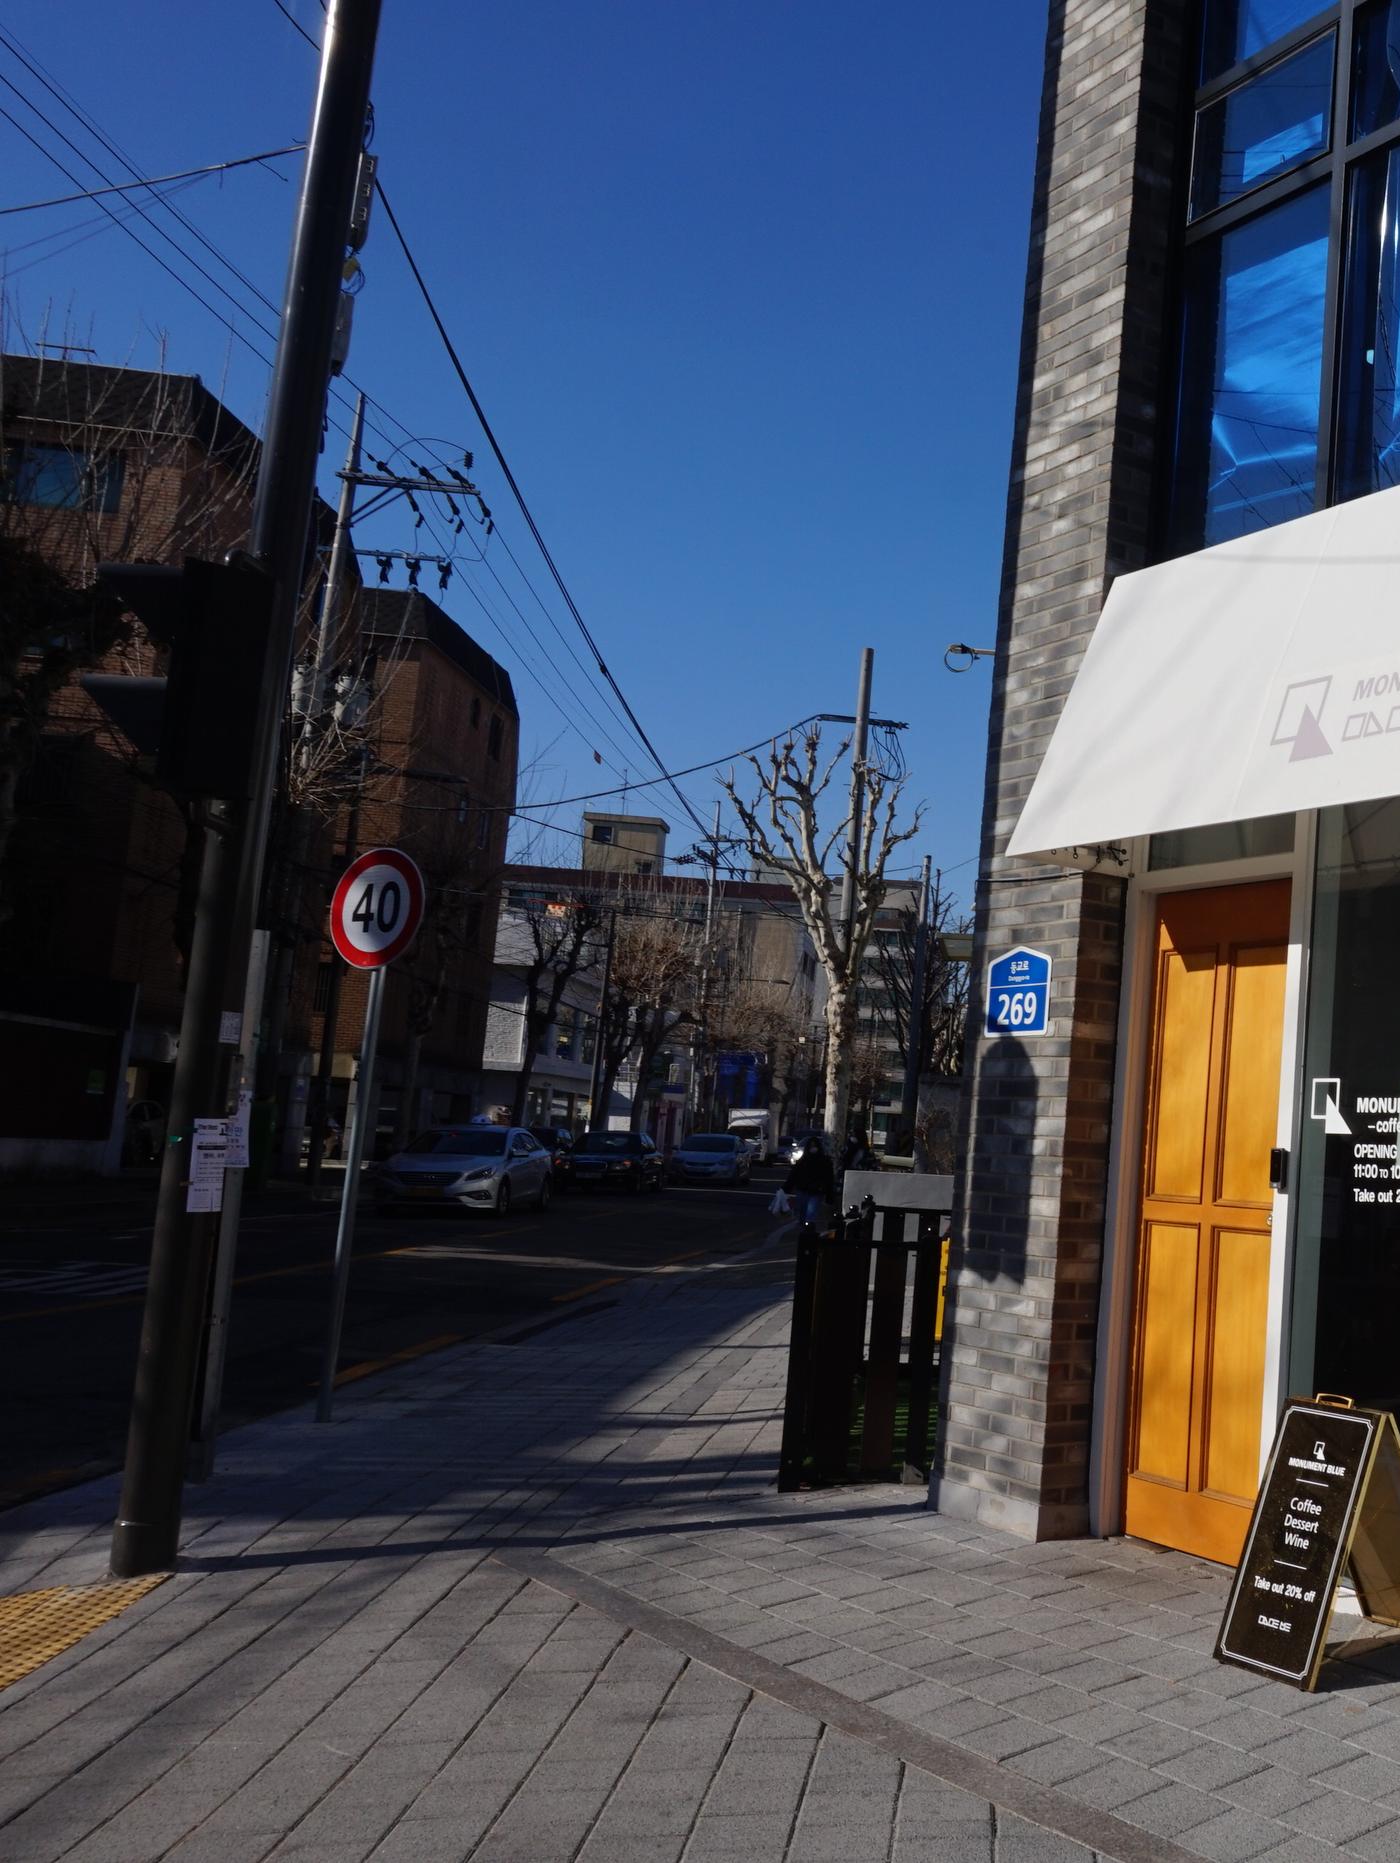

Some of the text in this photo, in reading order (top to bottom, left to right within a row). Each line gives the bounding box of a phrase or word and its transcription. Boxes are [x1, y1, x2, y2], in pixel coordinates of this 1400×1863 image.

[351, 881, 401, 933] 40
[996, 991, 1037, 1026] 269
[1353, 1143, 1398, 1160] OPENING
[1353, 1164, 1378, 1179] 11:00
[1379, 1168, 1388, 1179] TO
[1353, 1188, 1375, 1203] Take
[1377, 1190, 1394, 1203] out
[1288, 1456, 1346, 1477] MONUMENT BLUE
[1290, 1497, 1322, 1516] Coffee
[1284, 1514, 1319, 1534] Dessert
[1284, 1532, 1309, 1550] Wine
[1254, 1575, 1316, 1603] Take out 20% off
